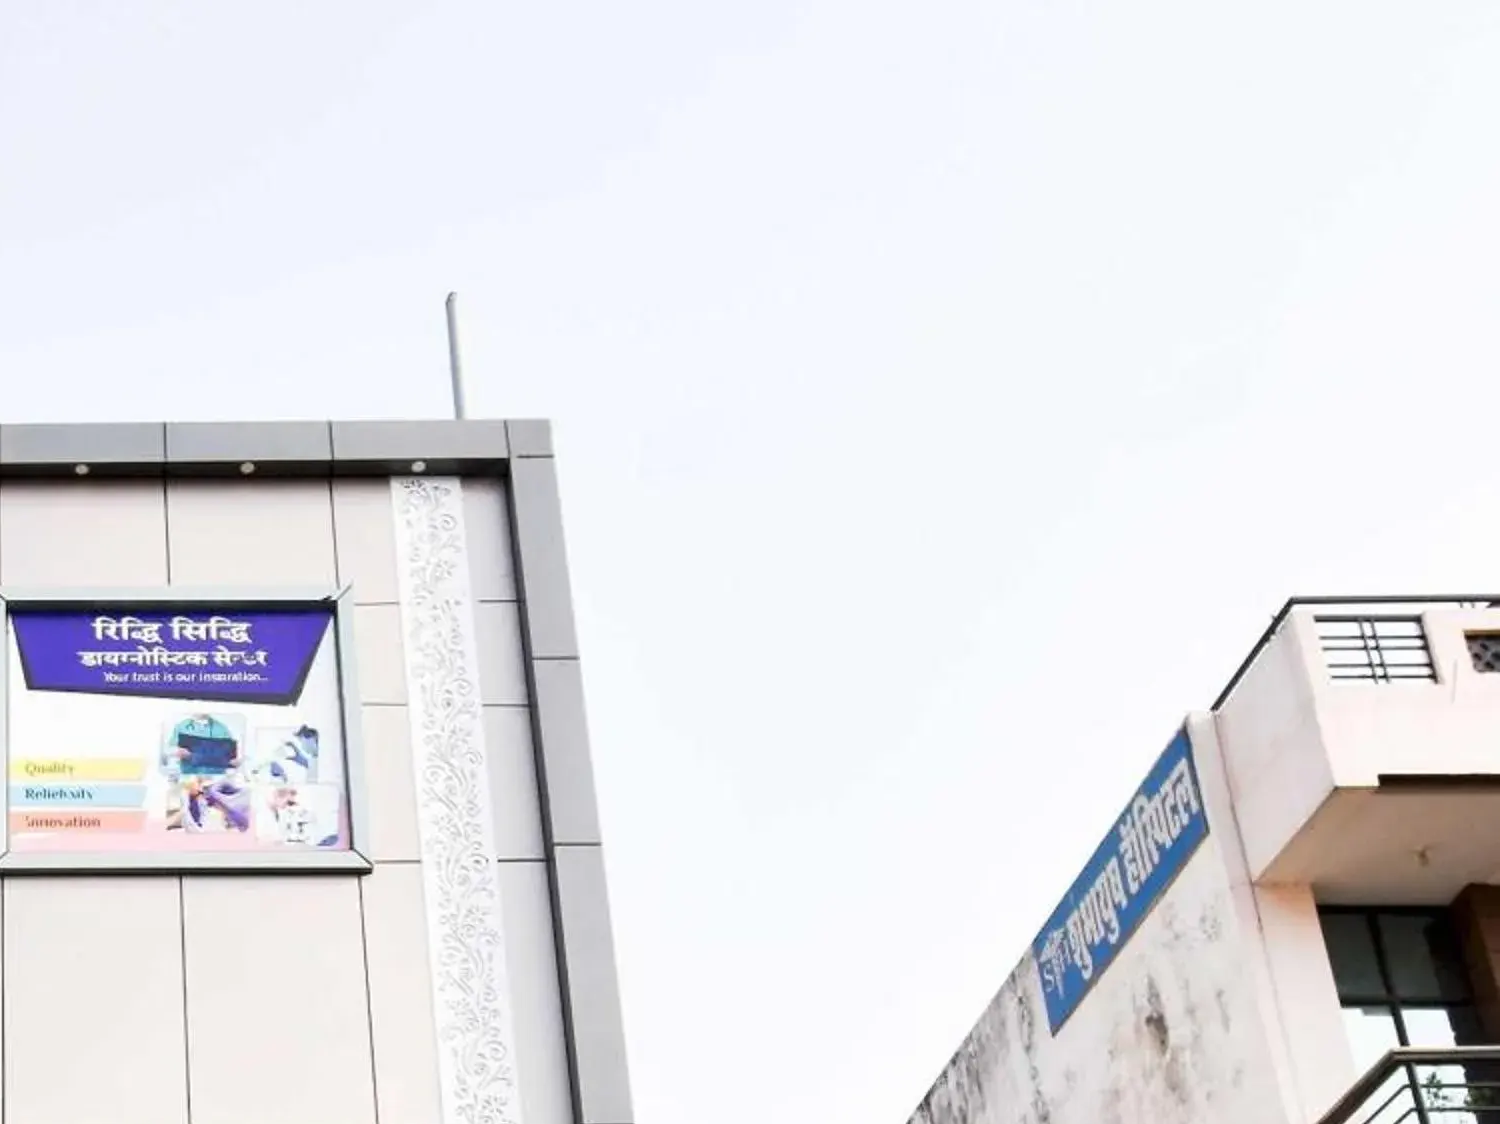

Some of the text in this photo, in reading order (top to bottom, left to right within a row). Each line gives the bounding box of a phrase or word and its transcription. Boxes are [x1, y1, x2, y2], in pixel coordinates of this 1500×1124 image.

[91, 616, 253, 644] रिद्धि सिद्धि
[103, 672, 129, 683] Your
[132, 672, 160, 683] trust
[163, 672, 174, 683] is
[175, 673, 196, 683] our
[25, 761, 76, 777] Quality
